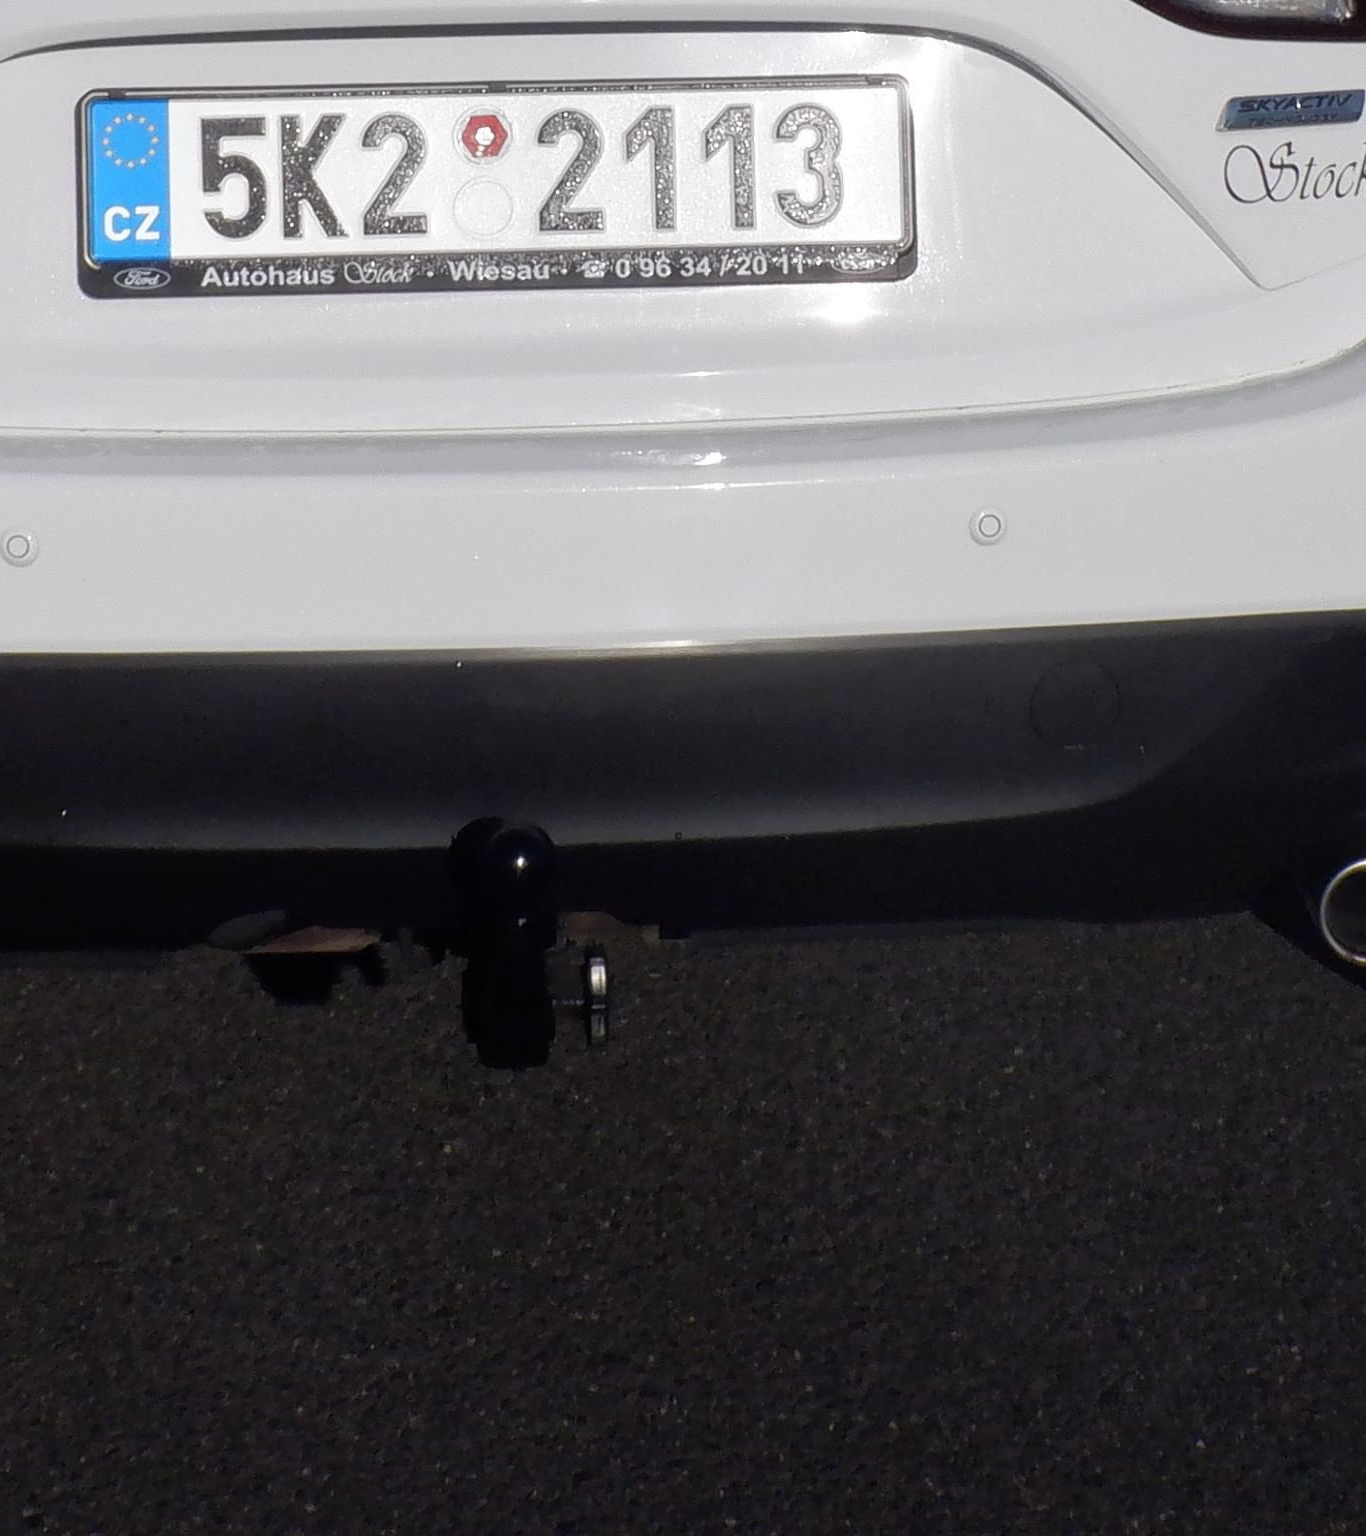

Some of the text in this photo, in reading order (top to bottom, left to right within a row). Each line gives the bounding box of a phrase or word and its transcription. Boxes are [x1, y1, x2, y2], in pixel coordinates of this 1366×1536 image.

[1237, 94, 1353, 113] SKYACTIV
[199, 102, 844, 240] 5K2 2113
[103, 205, 161, 242] CZ
[200, 266, 336, 288] Autohaus
[447, 259, 550, 282] Wiesau
[615, 258, 631, 279] 0
[639, 257, 672, 279] 96
[679, 256, 711, 277] 34
[736, 255, 767, 276] 20
